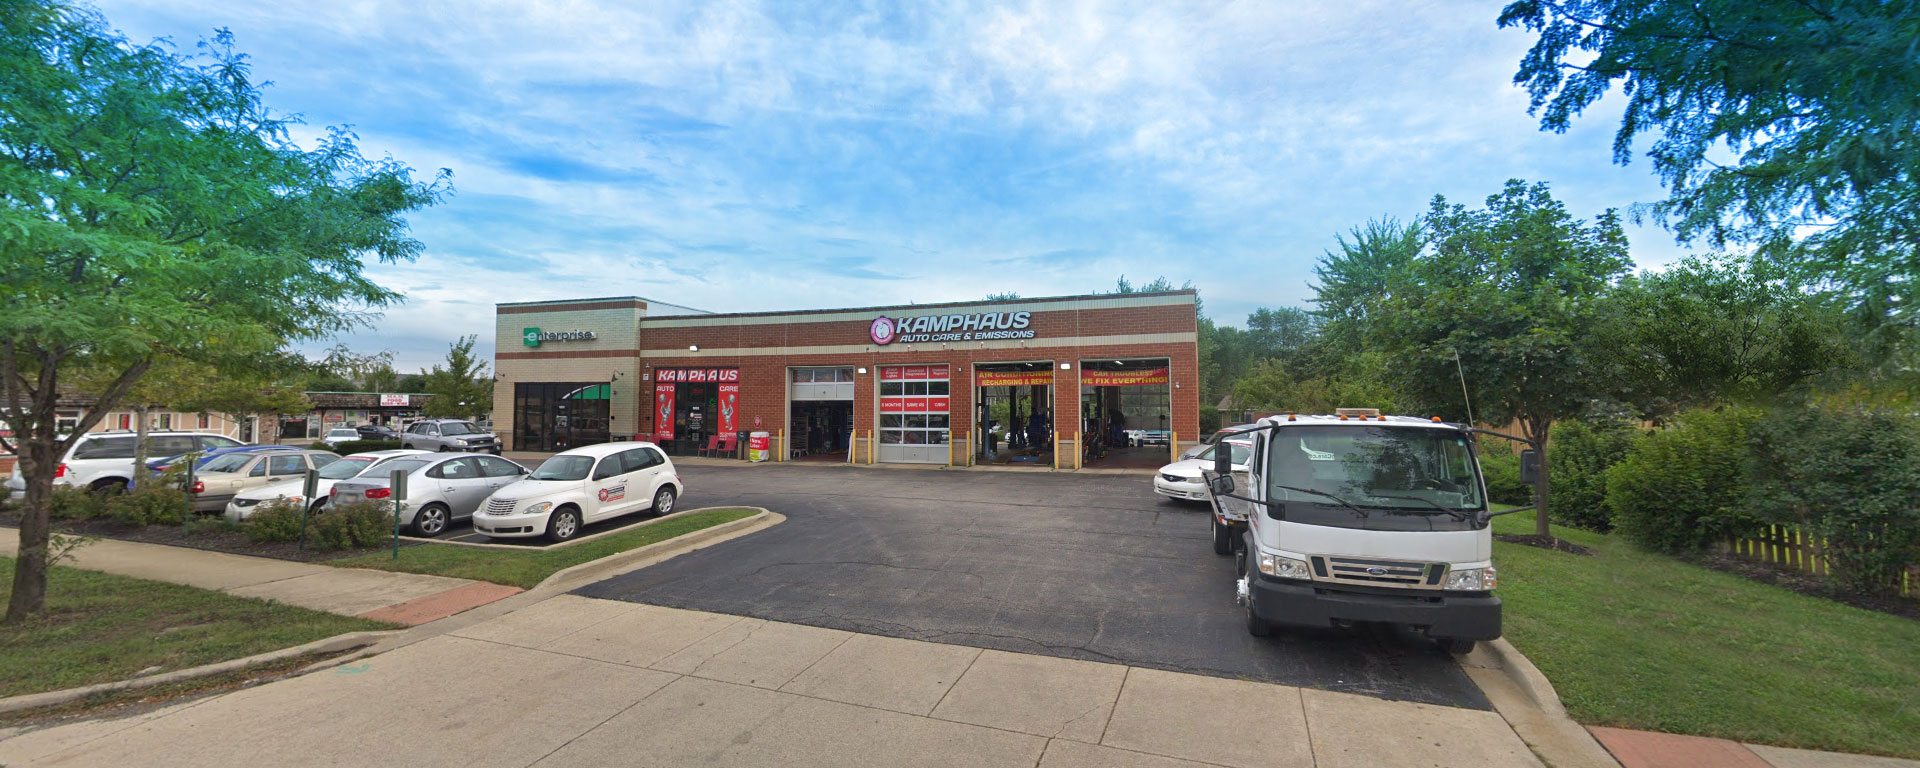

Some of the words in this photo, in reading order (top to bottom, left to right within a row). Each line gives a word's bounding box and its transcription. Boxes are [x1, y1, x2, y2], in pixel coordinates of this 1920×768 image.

[896, 311, 1030, 333] KAMPHAUS
[527, 329, 593, 342] enterprise
[900, 334, 929, 342] AUTO
[931, 333, 961, 342] CARE
[974, 330, 1034, 340] EMISSIONS
[658, 370, 738, 381] KAMPHAUS
[1112, 376, 1168, 384] EVERYTHING!
